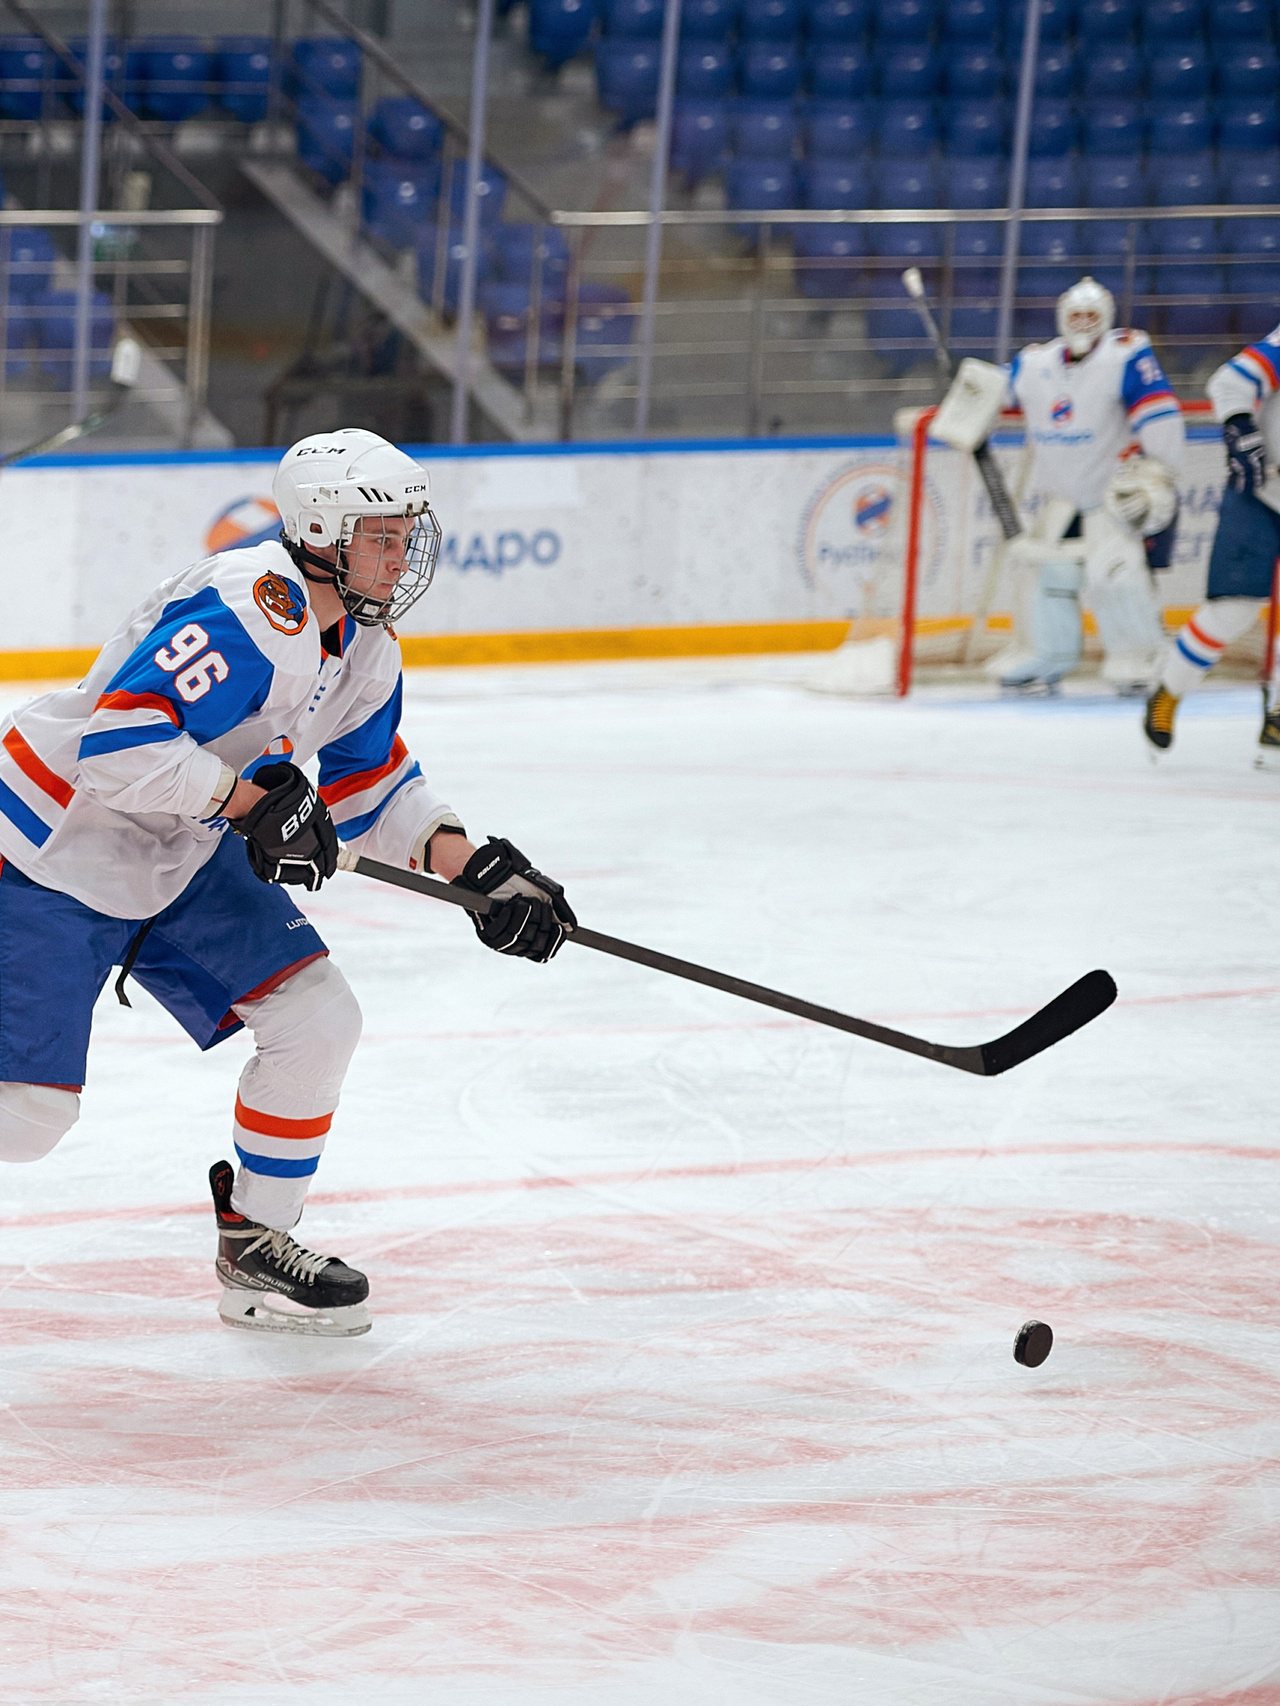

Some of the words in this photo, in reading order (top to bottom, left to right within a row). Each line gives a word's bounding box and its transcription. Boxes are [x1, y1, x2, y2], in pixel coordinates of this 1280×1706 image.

[296, 446, 347, 457] CCM
[404, 484, 427, 494] CCM
[154, 623, 230, 704] 96
[477, 855, 501, 880] BAUER
